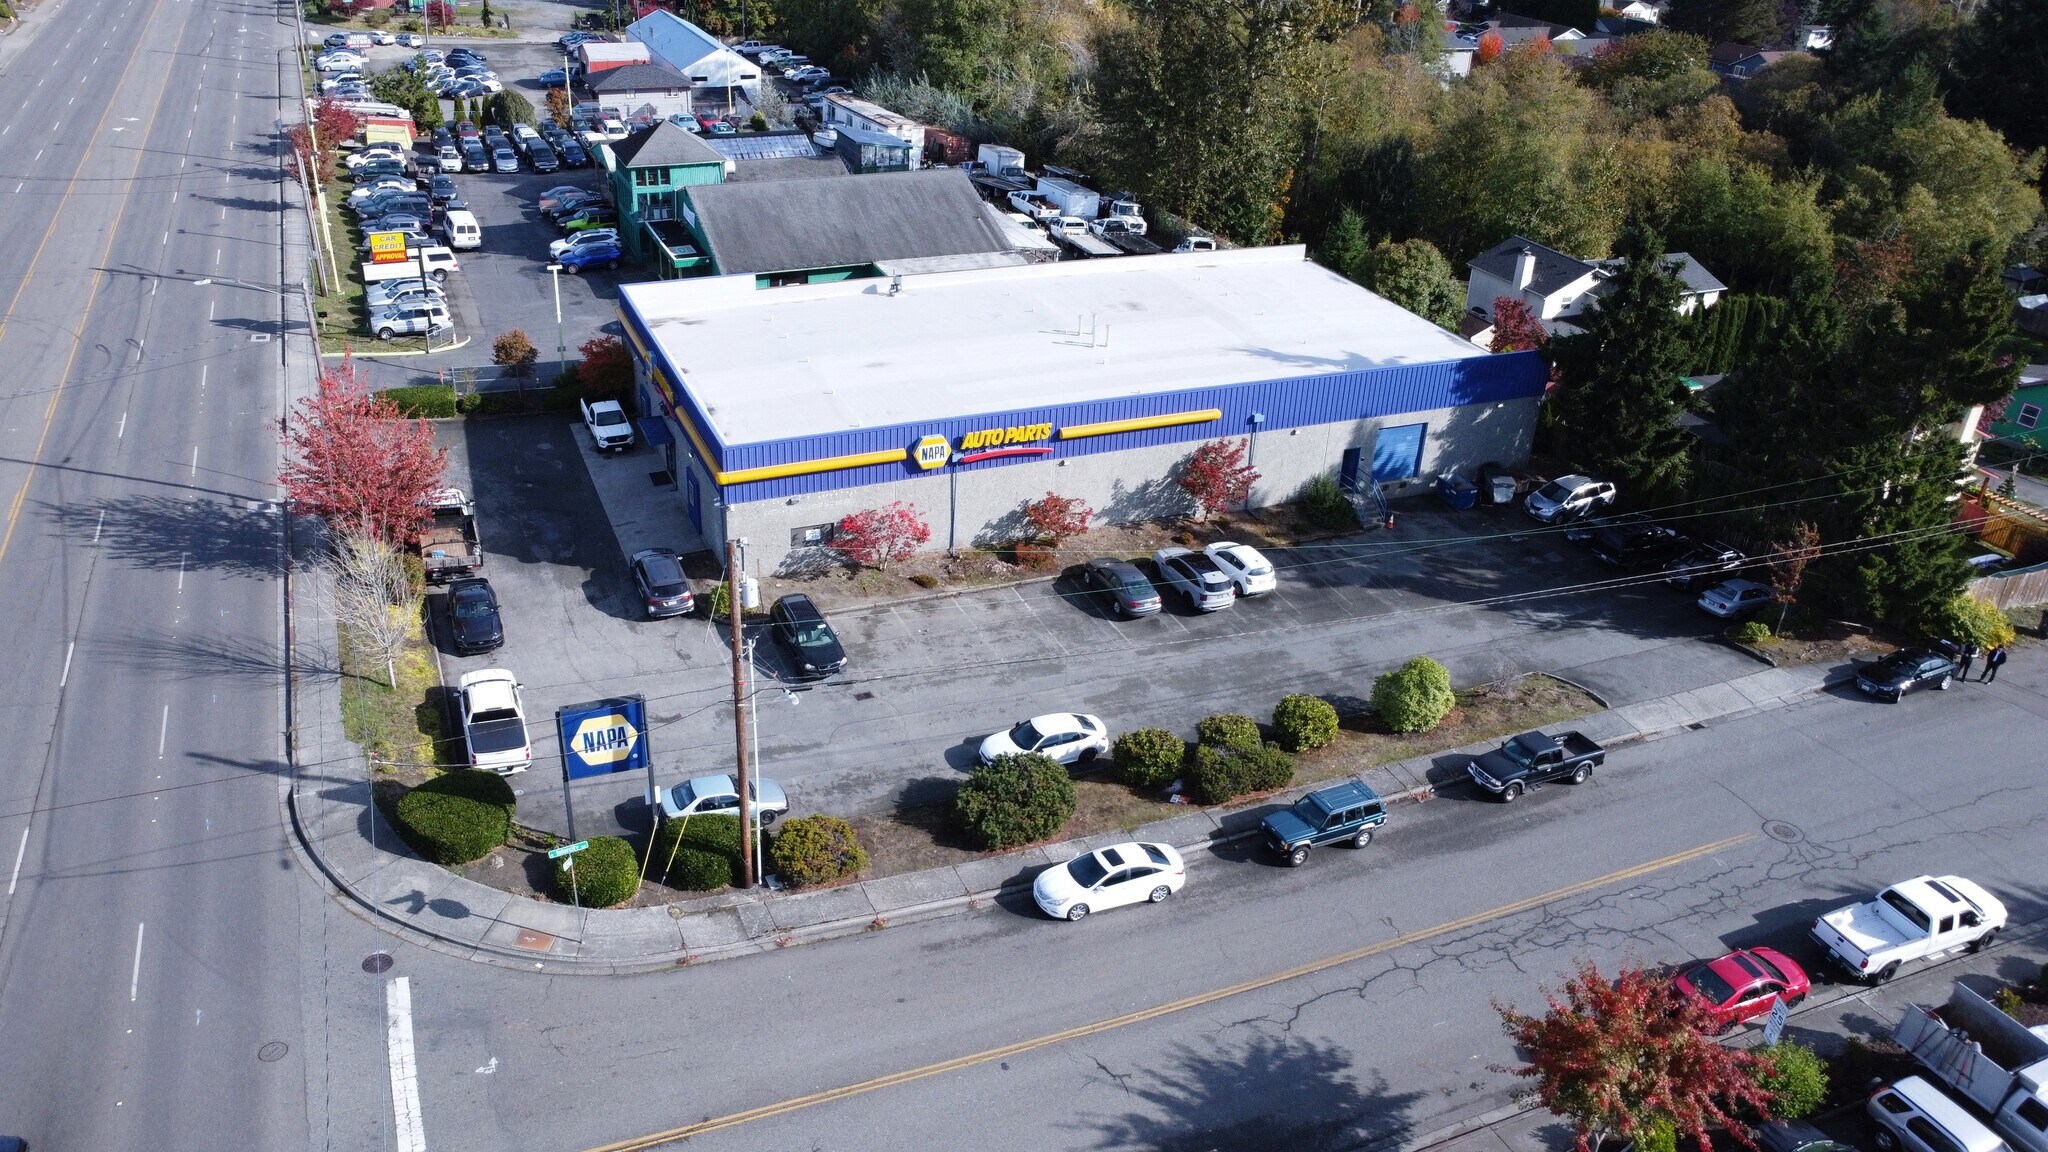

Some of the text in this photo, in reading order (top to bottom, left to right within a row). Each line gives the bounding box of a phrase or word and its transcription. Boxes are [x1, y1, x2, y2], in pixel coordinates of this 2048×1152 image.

[373, 242, 403, 250] CREDIT
[375, 252, 406, 261] APPROVAL
[960, 423, 1052, 450] AUTO PARTS
[921, 445, 945, 461] NAPA
[582, 726, 629, 754] NAPA
[1771, 1007, 1784, 1026] 25
